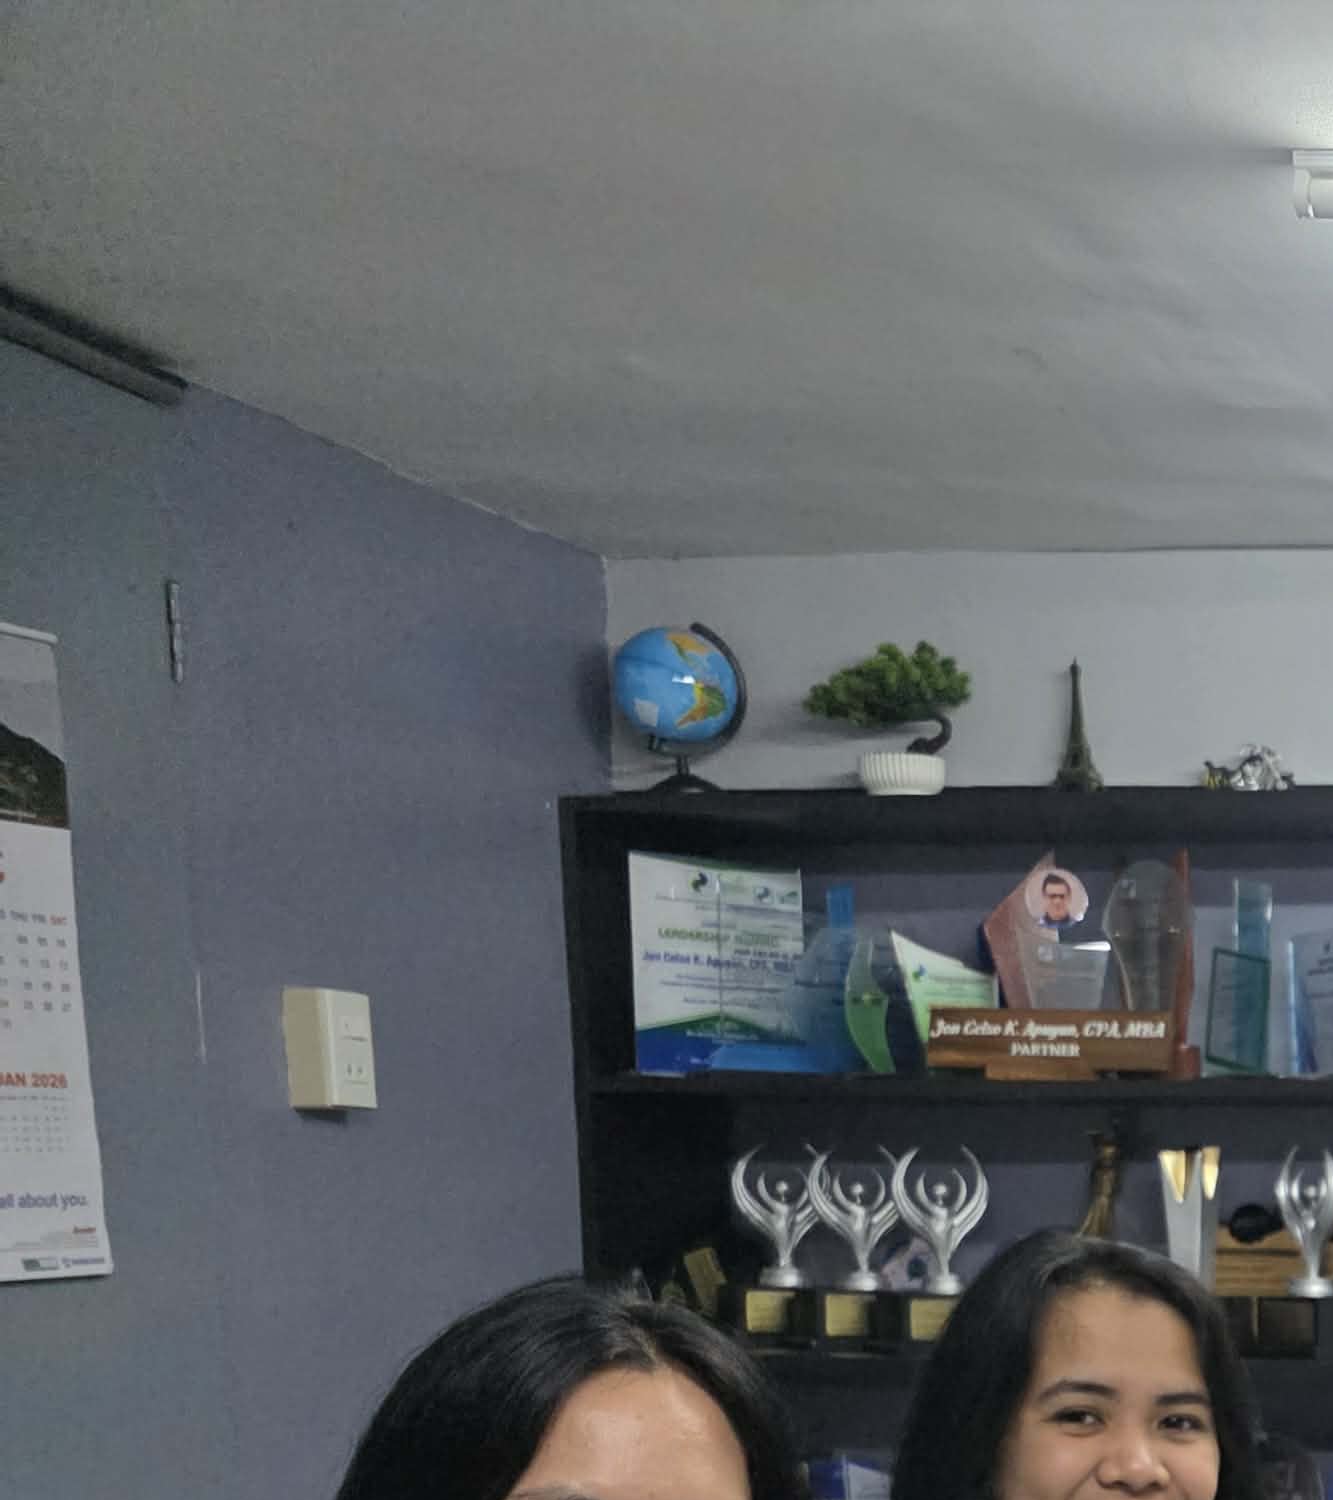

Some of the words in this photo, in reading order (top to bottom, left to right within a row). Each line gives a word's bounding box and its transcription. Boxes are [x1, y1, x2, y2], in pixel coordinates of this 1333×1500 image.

[1010, 1042, 1081, 1057] PARTNER
[31, 1072, 68, 1089] 2026
[18, 1192, 58, 1209] about
